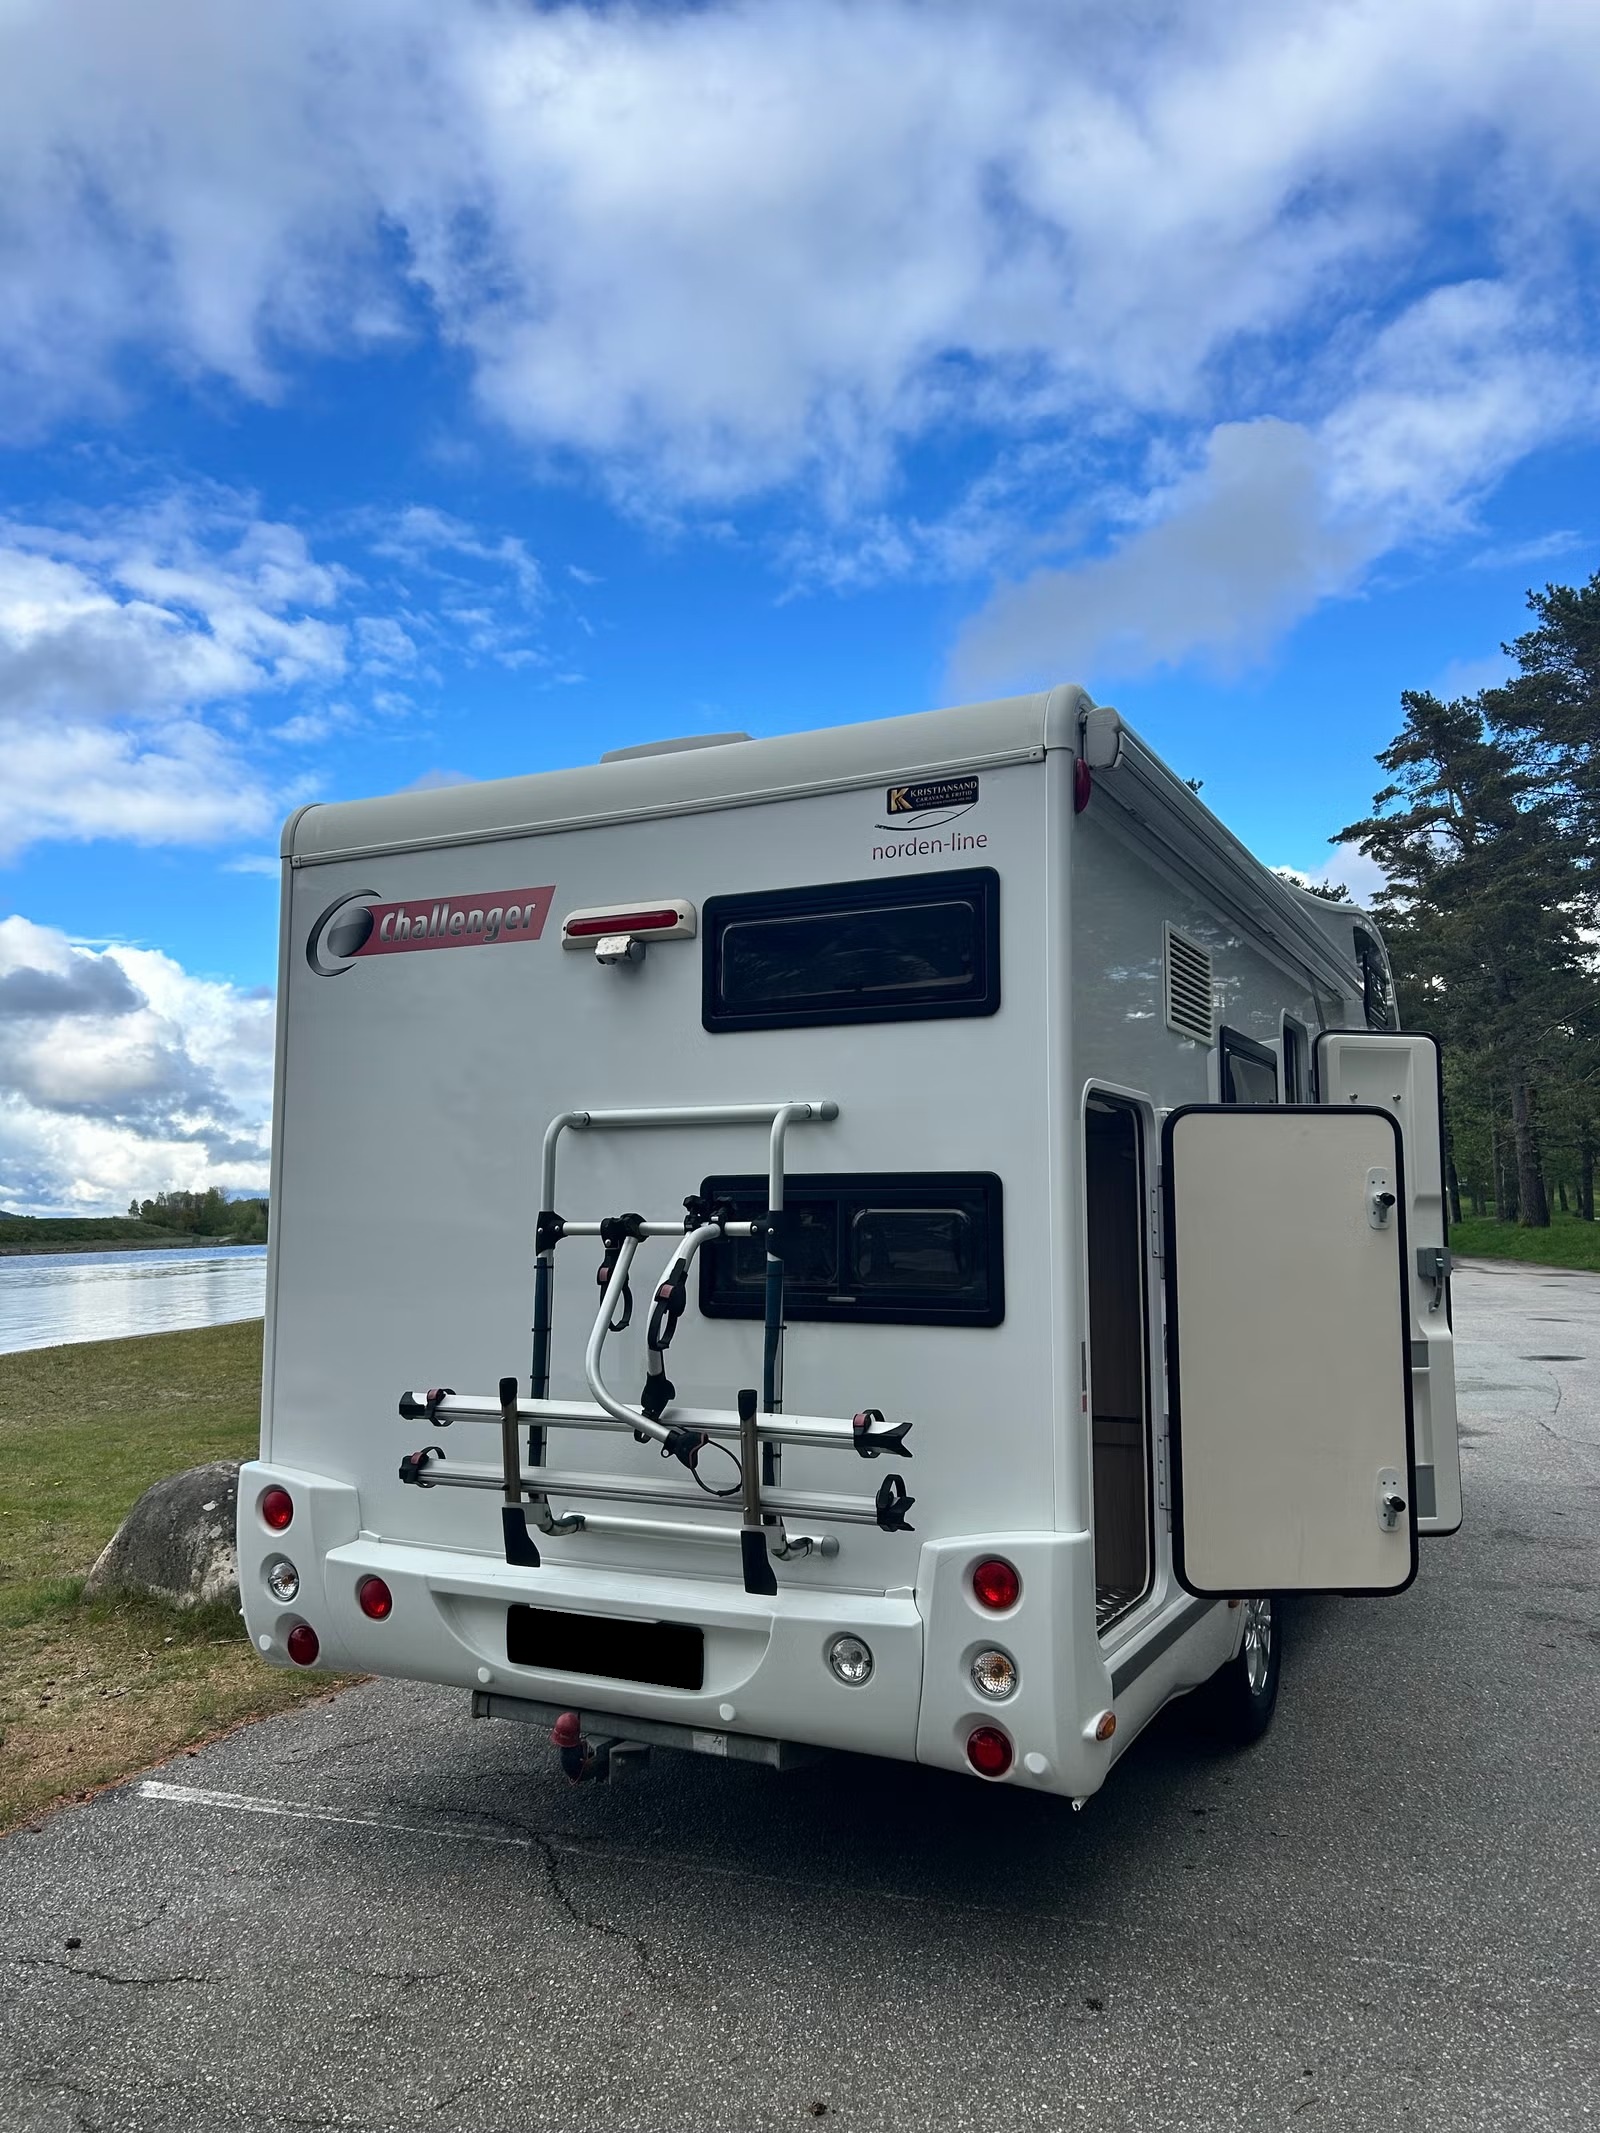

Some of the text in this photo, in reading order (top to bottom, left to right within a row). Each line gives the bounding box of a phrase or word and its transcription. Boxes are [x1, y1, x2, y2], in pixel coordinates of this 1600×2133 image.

[910, 781, 977, 797] KRISTIANSAND
[915, 795, 944, 803] CARAVAN
[872, 832, 988, 860] norden-line
[380, 903, 536, 942] Challenger
